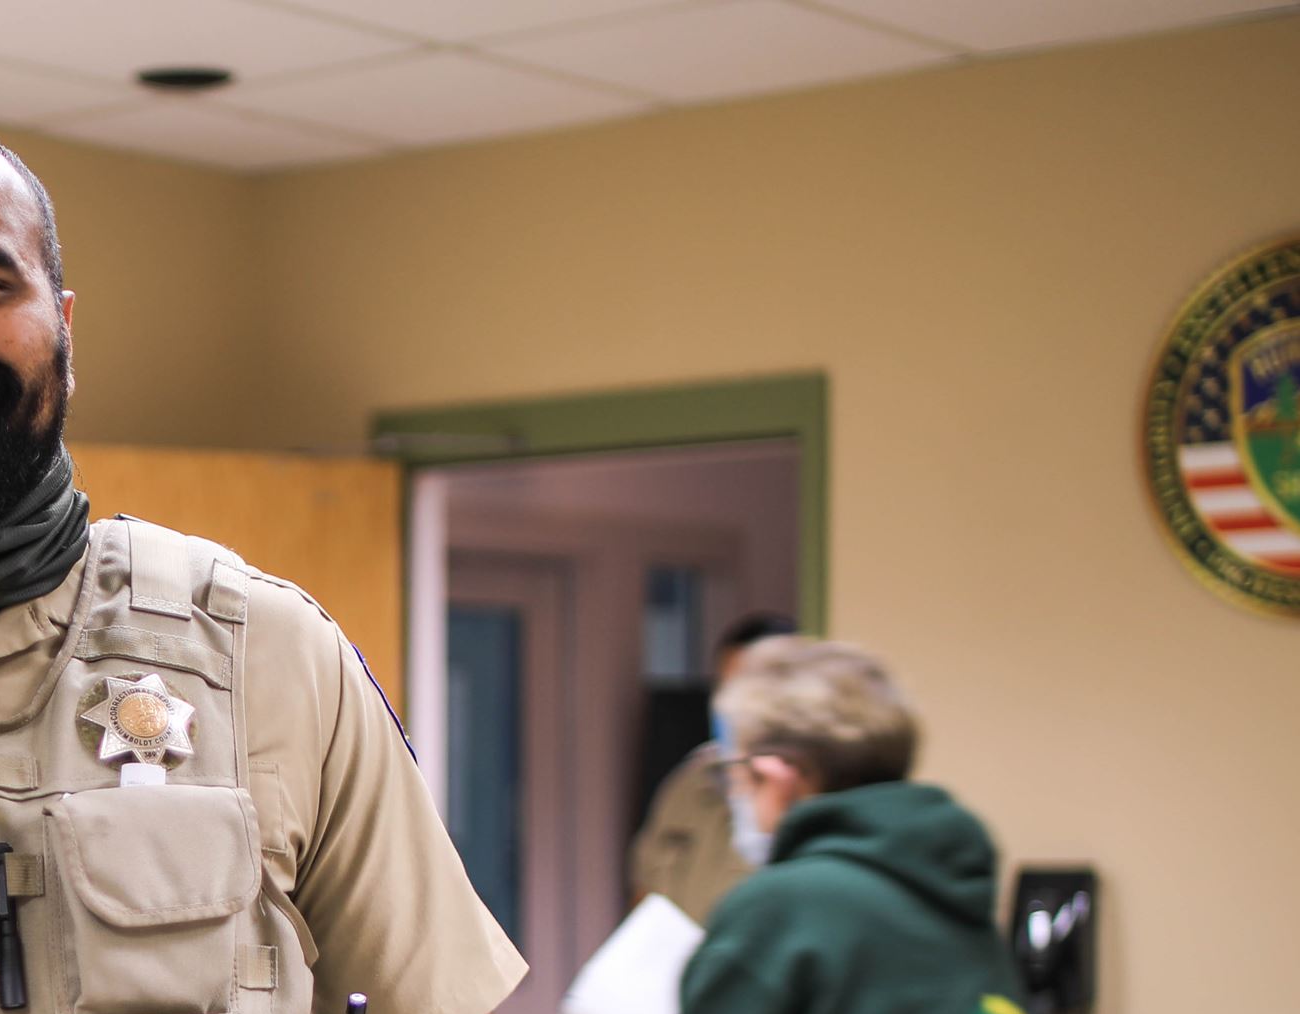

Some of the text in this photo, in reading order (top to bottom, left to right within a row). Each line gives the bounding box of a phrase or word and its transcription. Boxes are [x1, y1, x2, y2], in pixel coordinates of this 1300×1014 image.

[110, 687, 151, 721] CORRECTIONAL
[114, 722, 174, 746] HUMBOLDT COUNT
